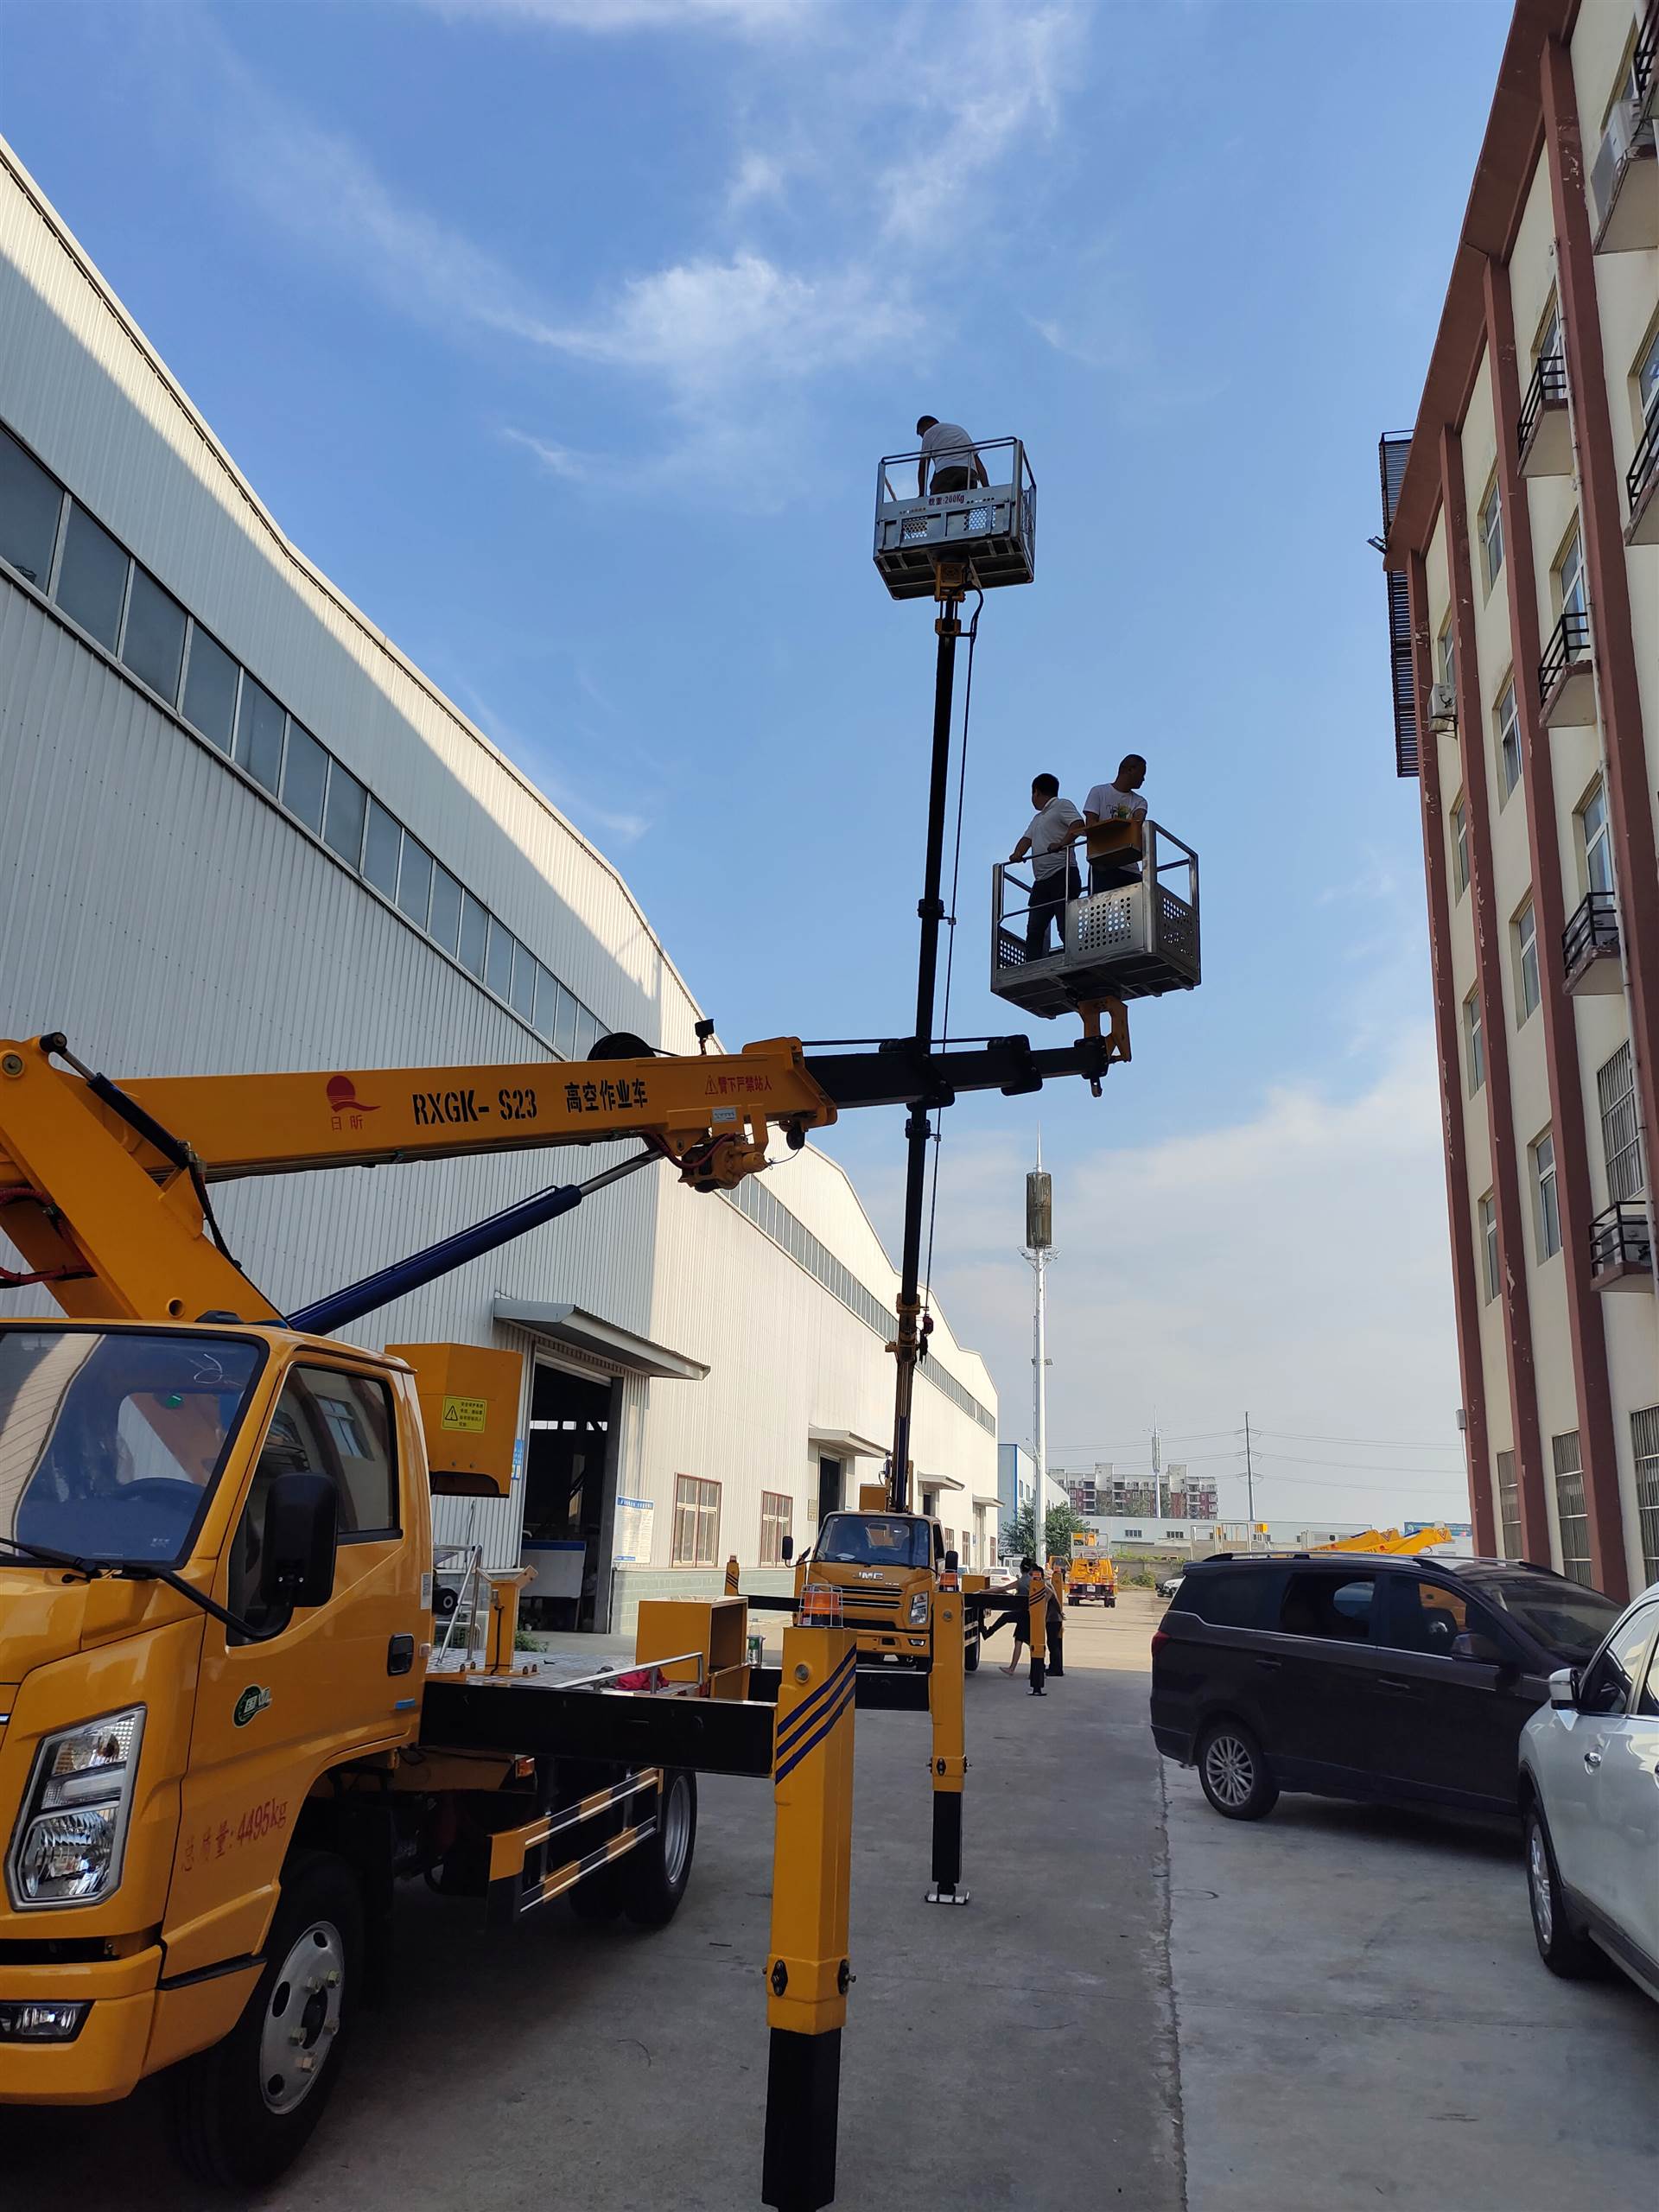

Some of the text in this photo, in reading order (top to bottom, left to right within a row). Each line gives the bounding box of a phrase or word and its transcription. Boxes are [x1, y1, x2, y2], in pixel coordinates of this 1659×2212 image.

[498, 1088, 537, 1121] S23
[564, 1078, 648, 1114] 高空作业车
[852, 1571, 884, 1580] JMC
